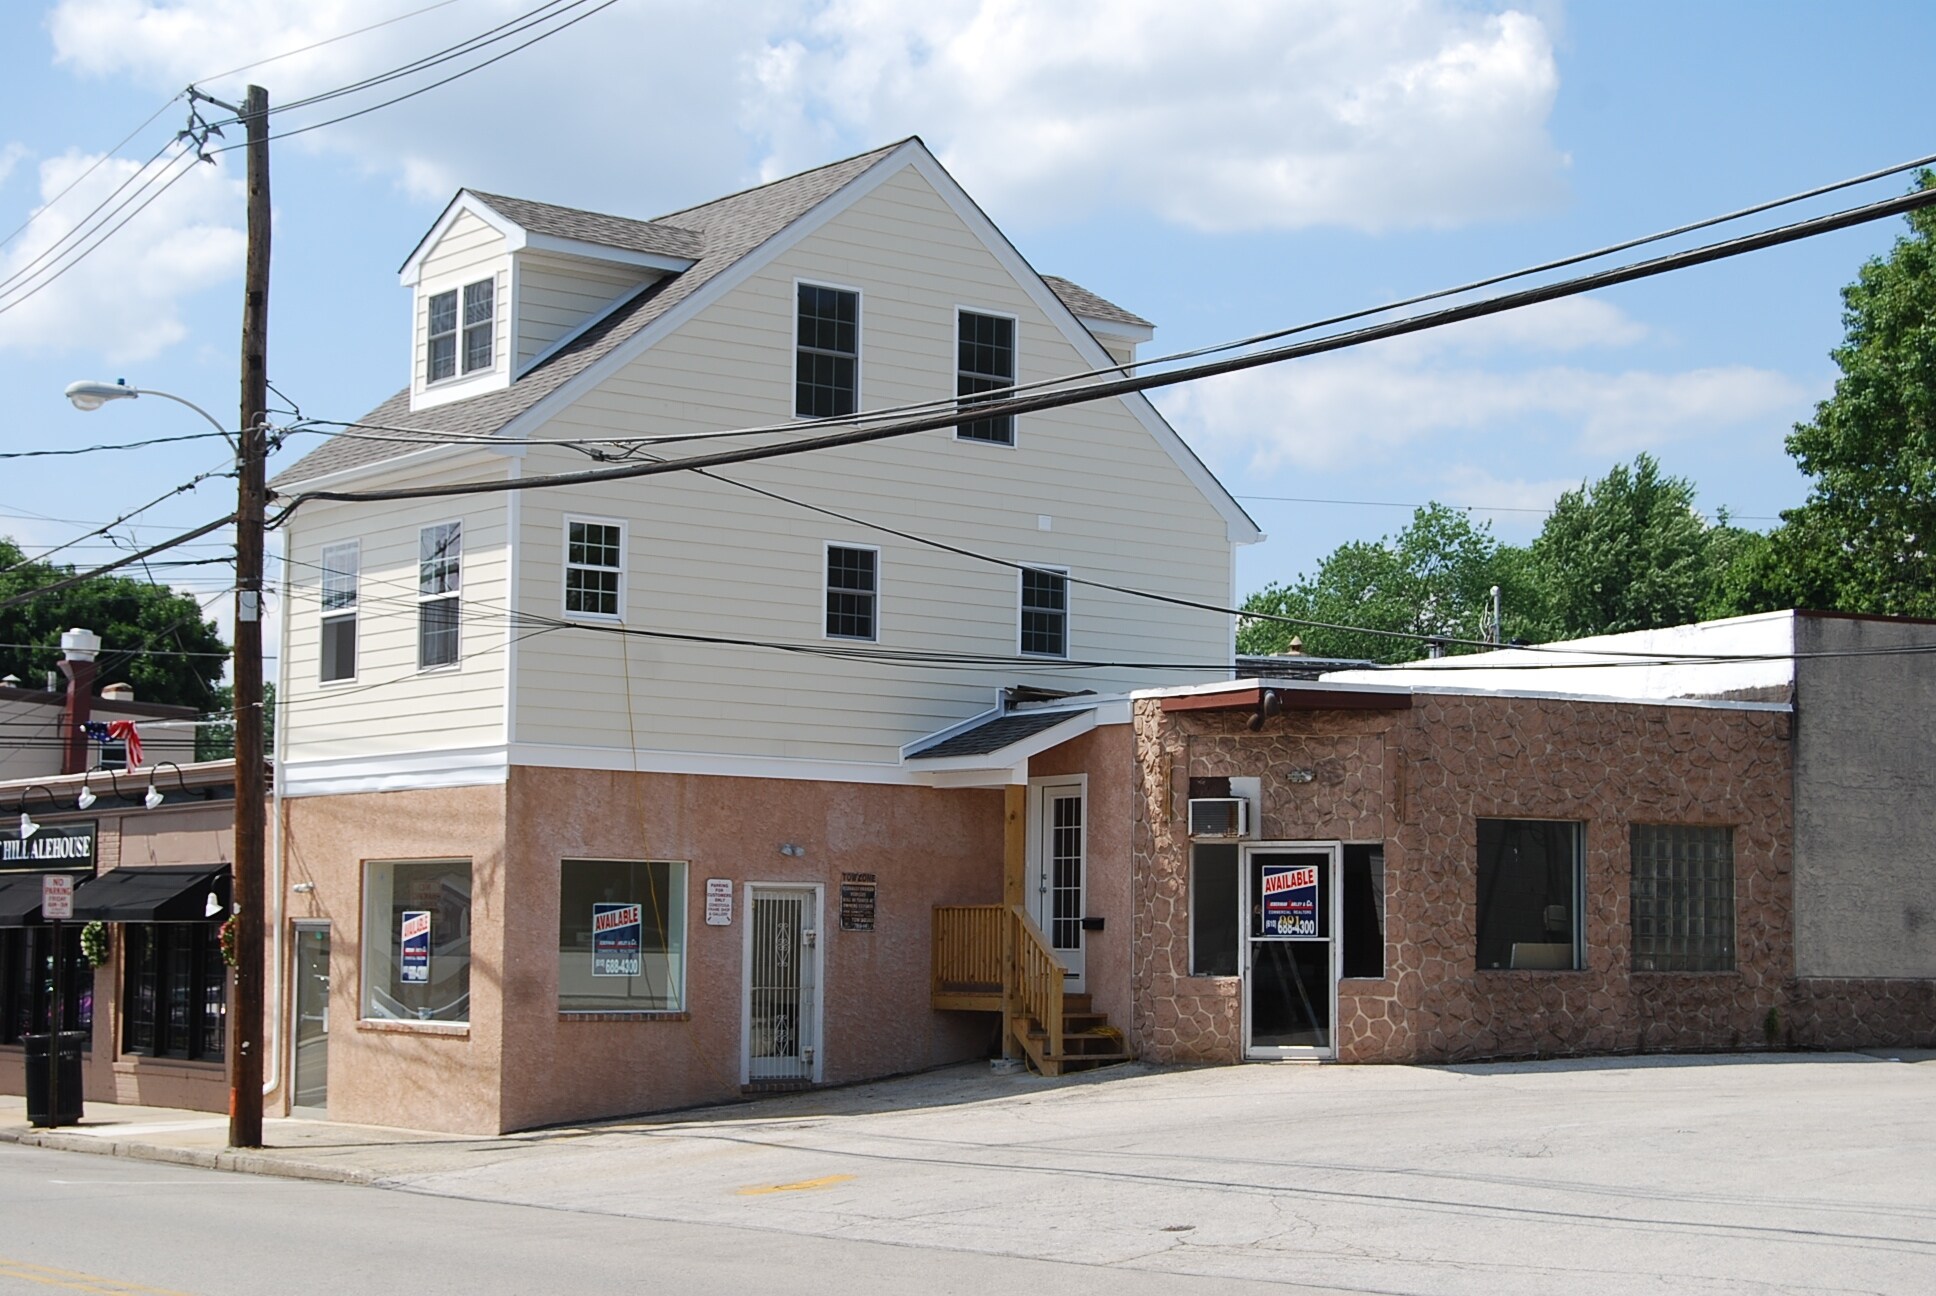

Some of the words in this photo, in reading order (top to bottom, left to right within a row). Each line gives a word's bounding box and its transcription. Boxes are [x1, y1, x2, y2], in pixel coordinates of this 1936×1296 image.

[3, 840, 29, 860] HILL
[30, 836, 91, 859] ALEHOUSE
[53, 878, 64, 886] NO
[1265, 869, 1314, 893] AVAILABLE
[45, 887, 71, 895] PARKING
[595, 907, 639, 931] AVAILABLE
[605, 959, 638, 974] 688-4300
